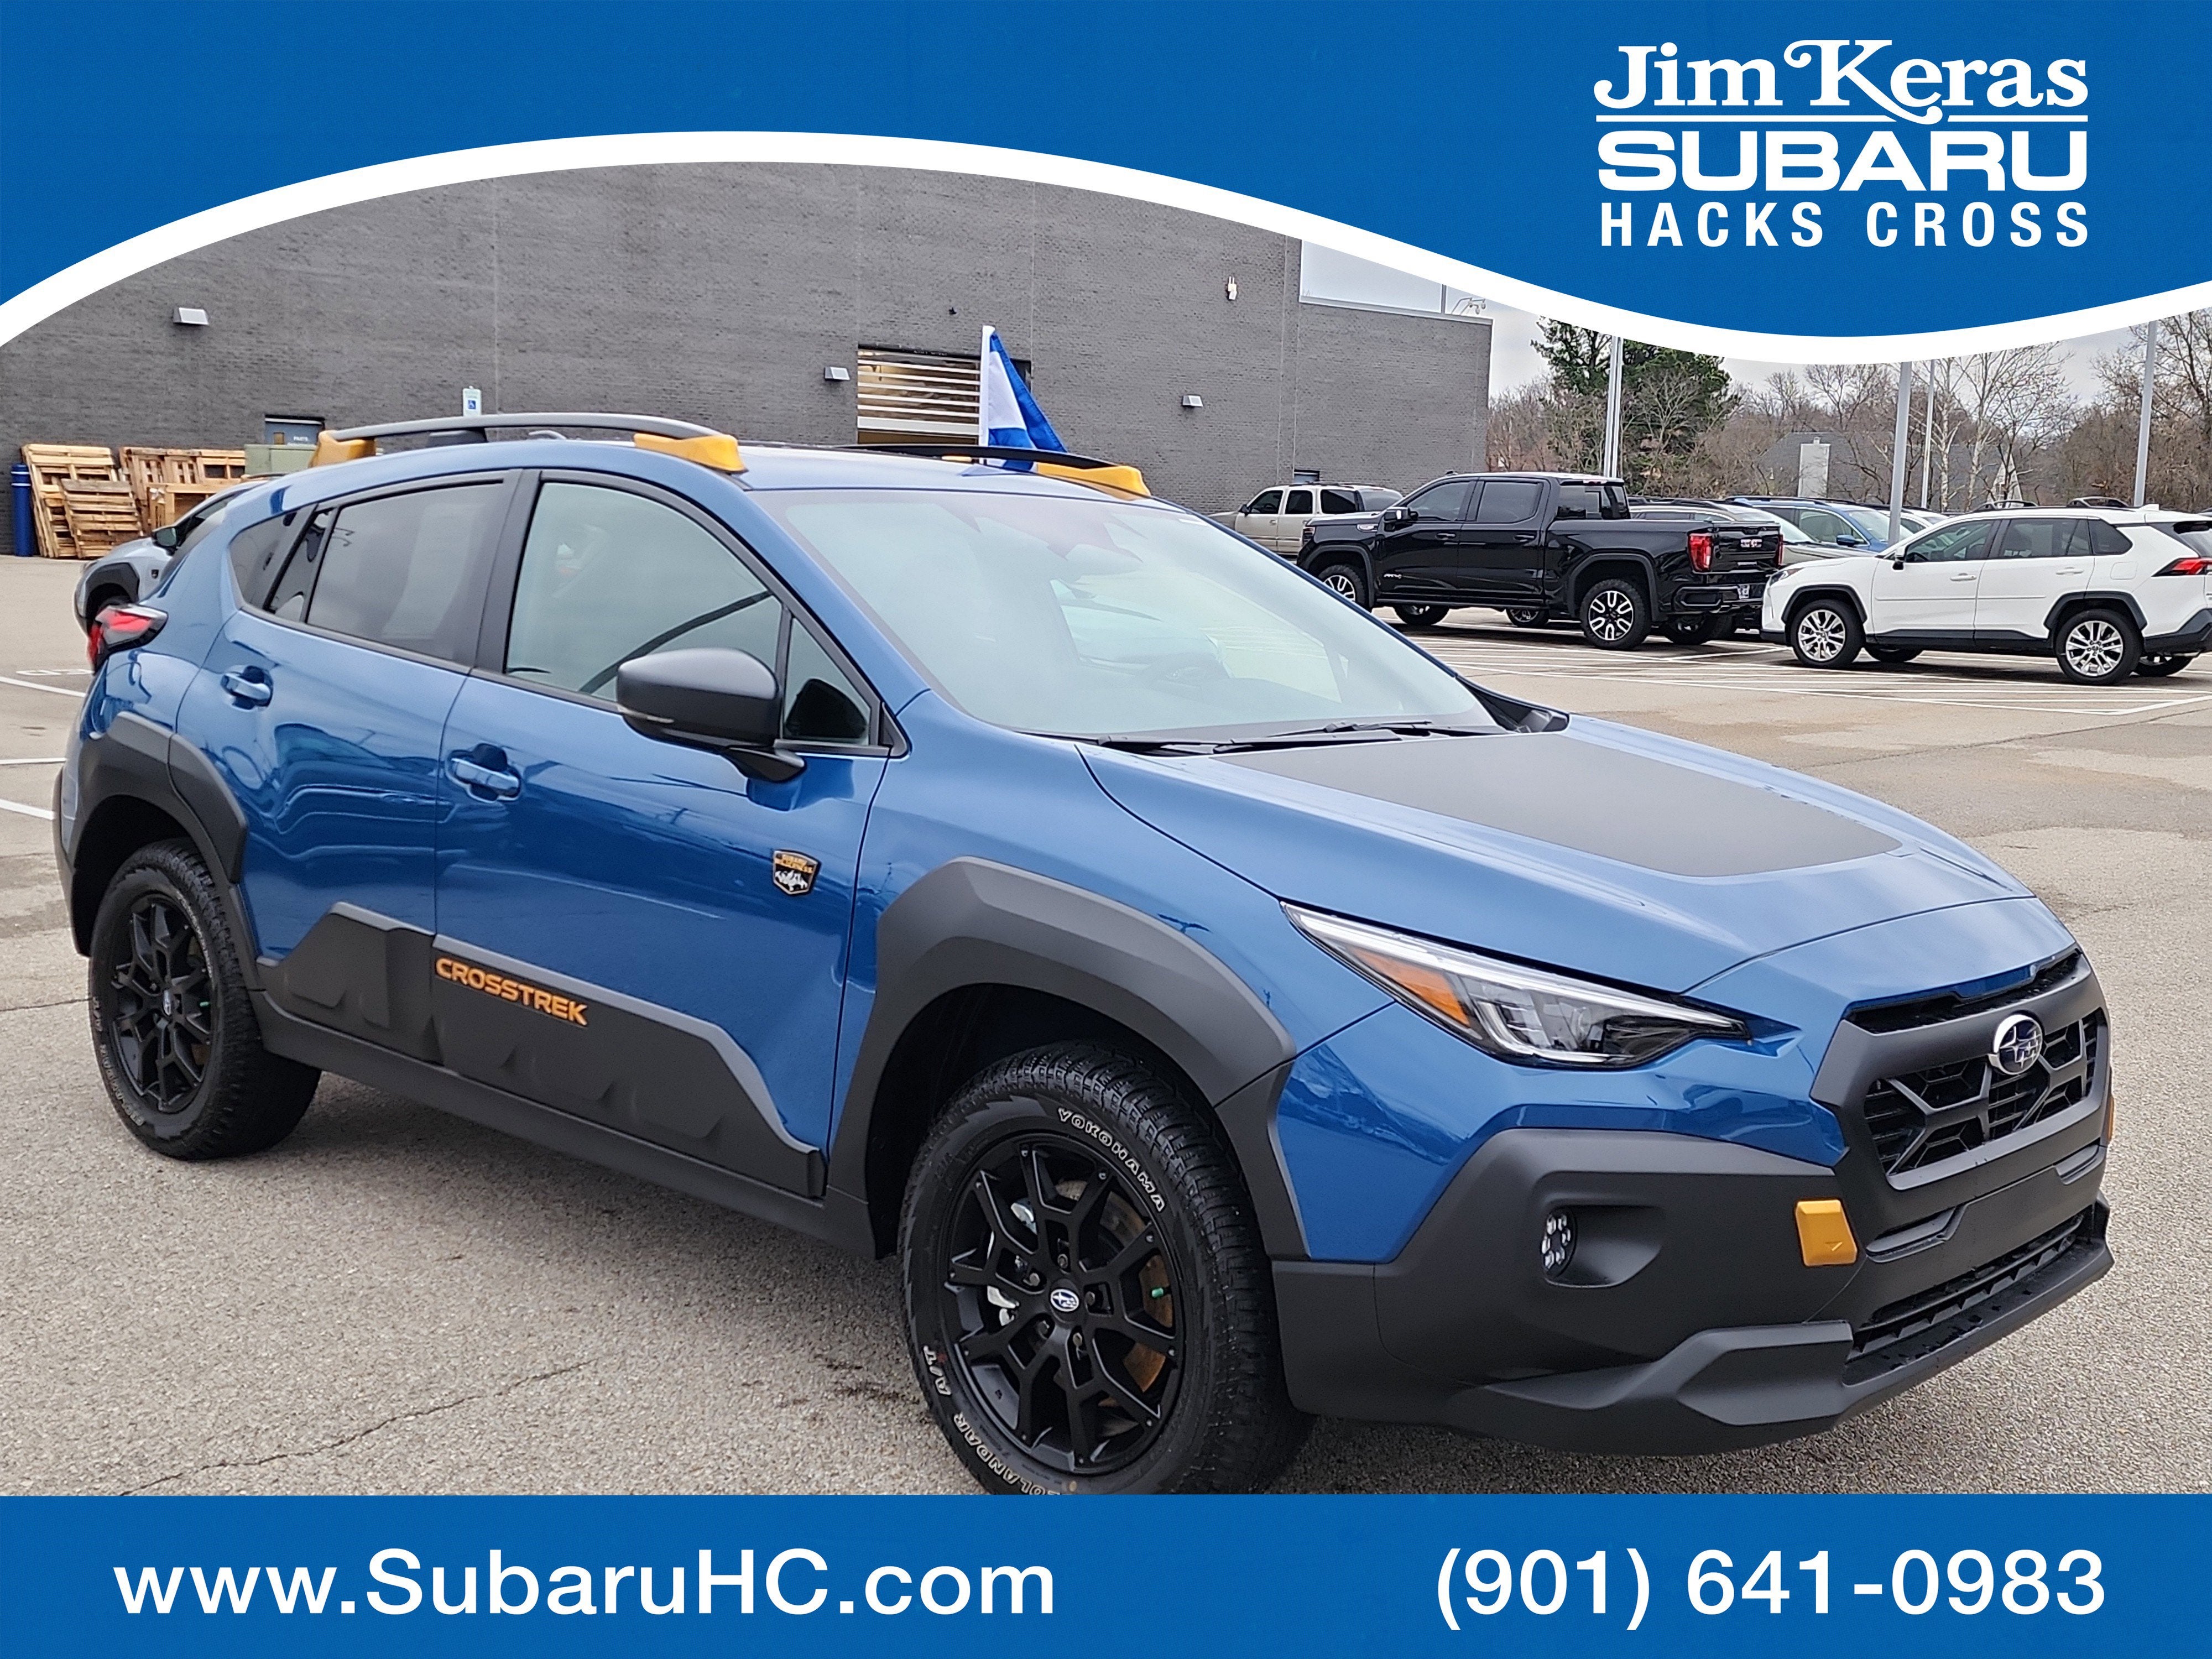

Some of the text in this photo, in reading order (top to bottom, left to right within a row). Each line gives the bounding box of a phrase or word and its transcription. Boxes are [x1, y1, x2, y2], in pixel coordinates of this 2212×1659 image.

[435, 957, 589, 1026] CROSSTREK
[1057, 1107, 1166, 1213] YOKOHAMA
[922, 1345, 952, 1396] A/T
